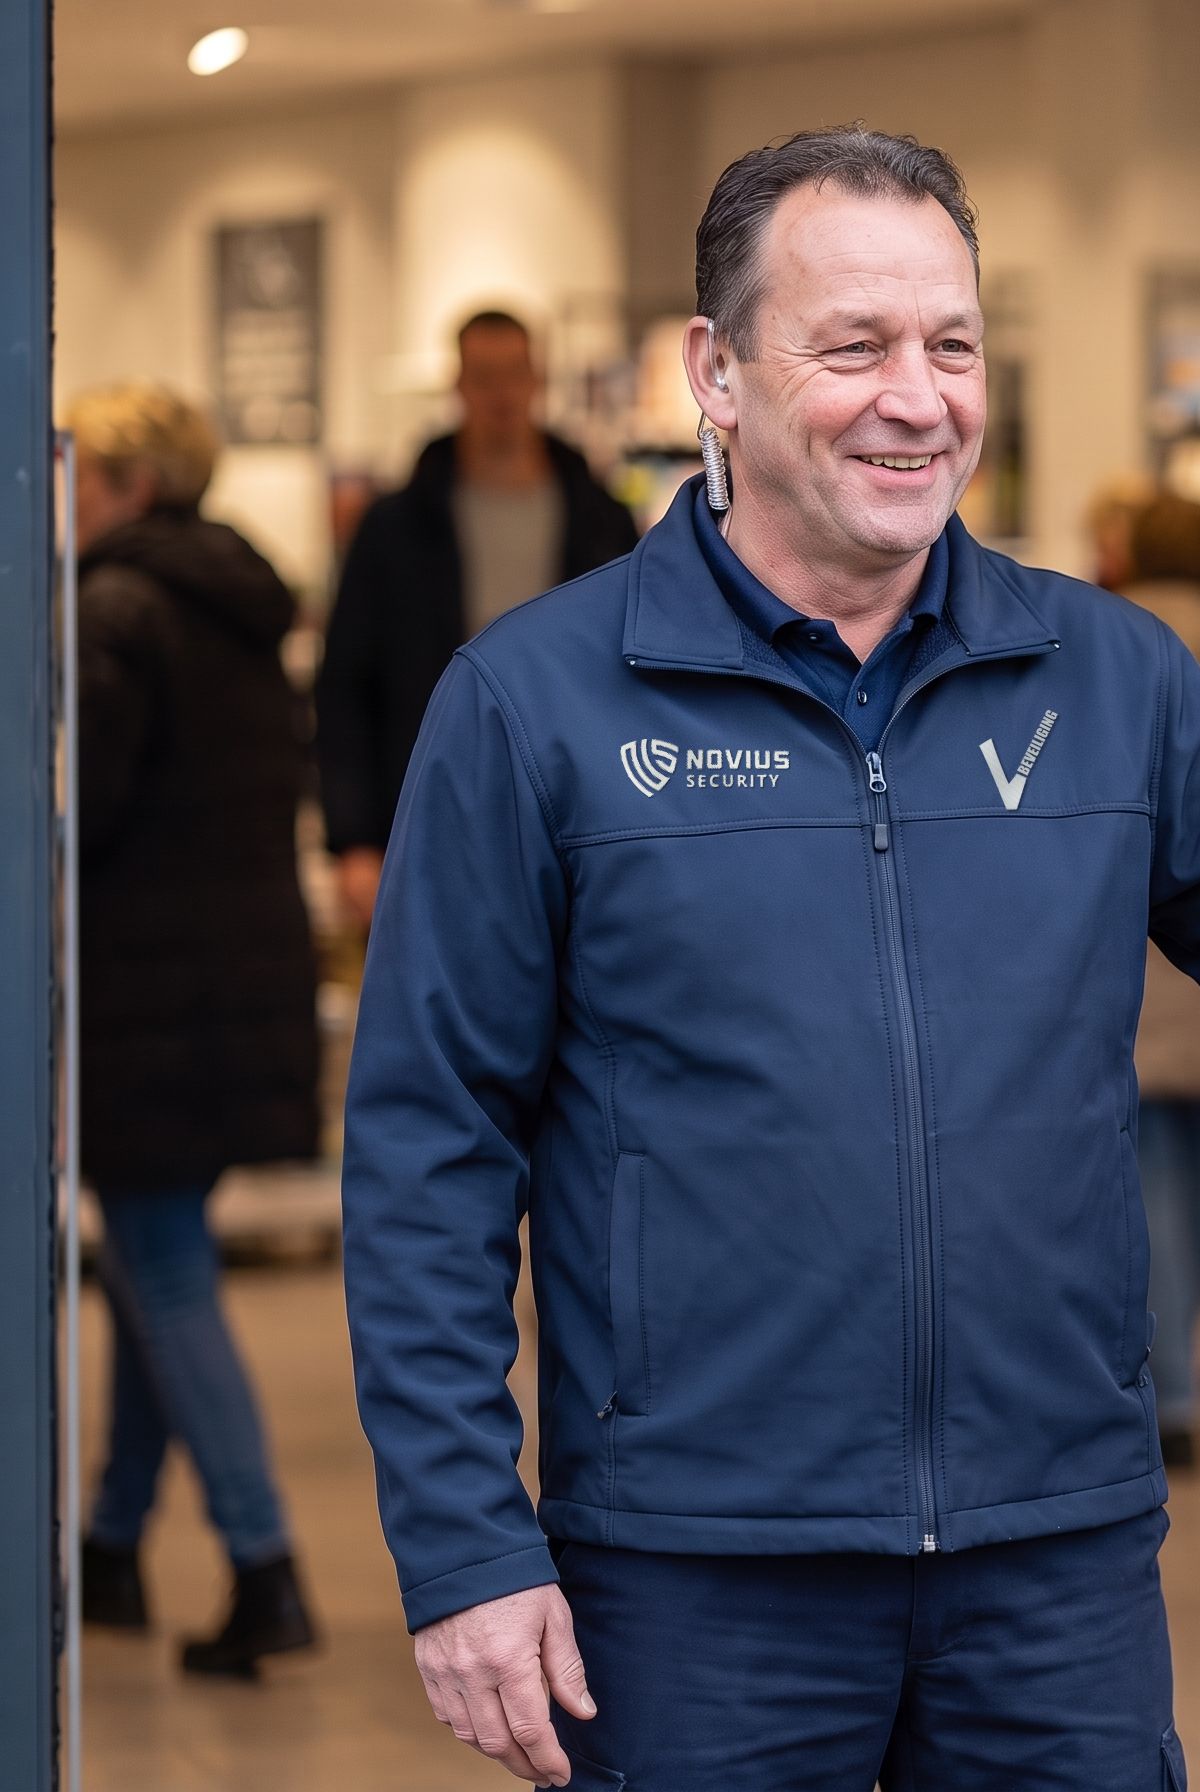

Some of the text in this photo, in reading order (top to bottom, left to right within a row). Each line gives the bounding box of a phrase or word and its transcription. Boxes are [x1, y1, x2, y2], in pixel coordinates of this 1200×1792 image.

[1016, 709, 1059, 777] BEVEILIGING
[686, 749, 790, 770] NOVIUS
[686, 774, 780, 788] SECURITY
